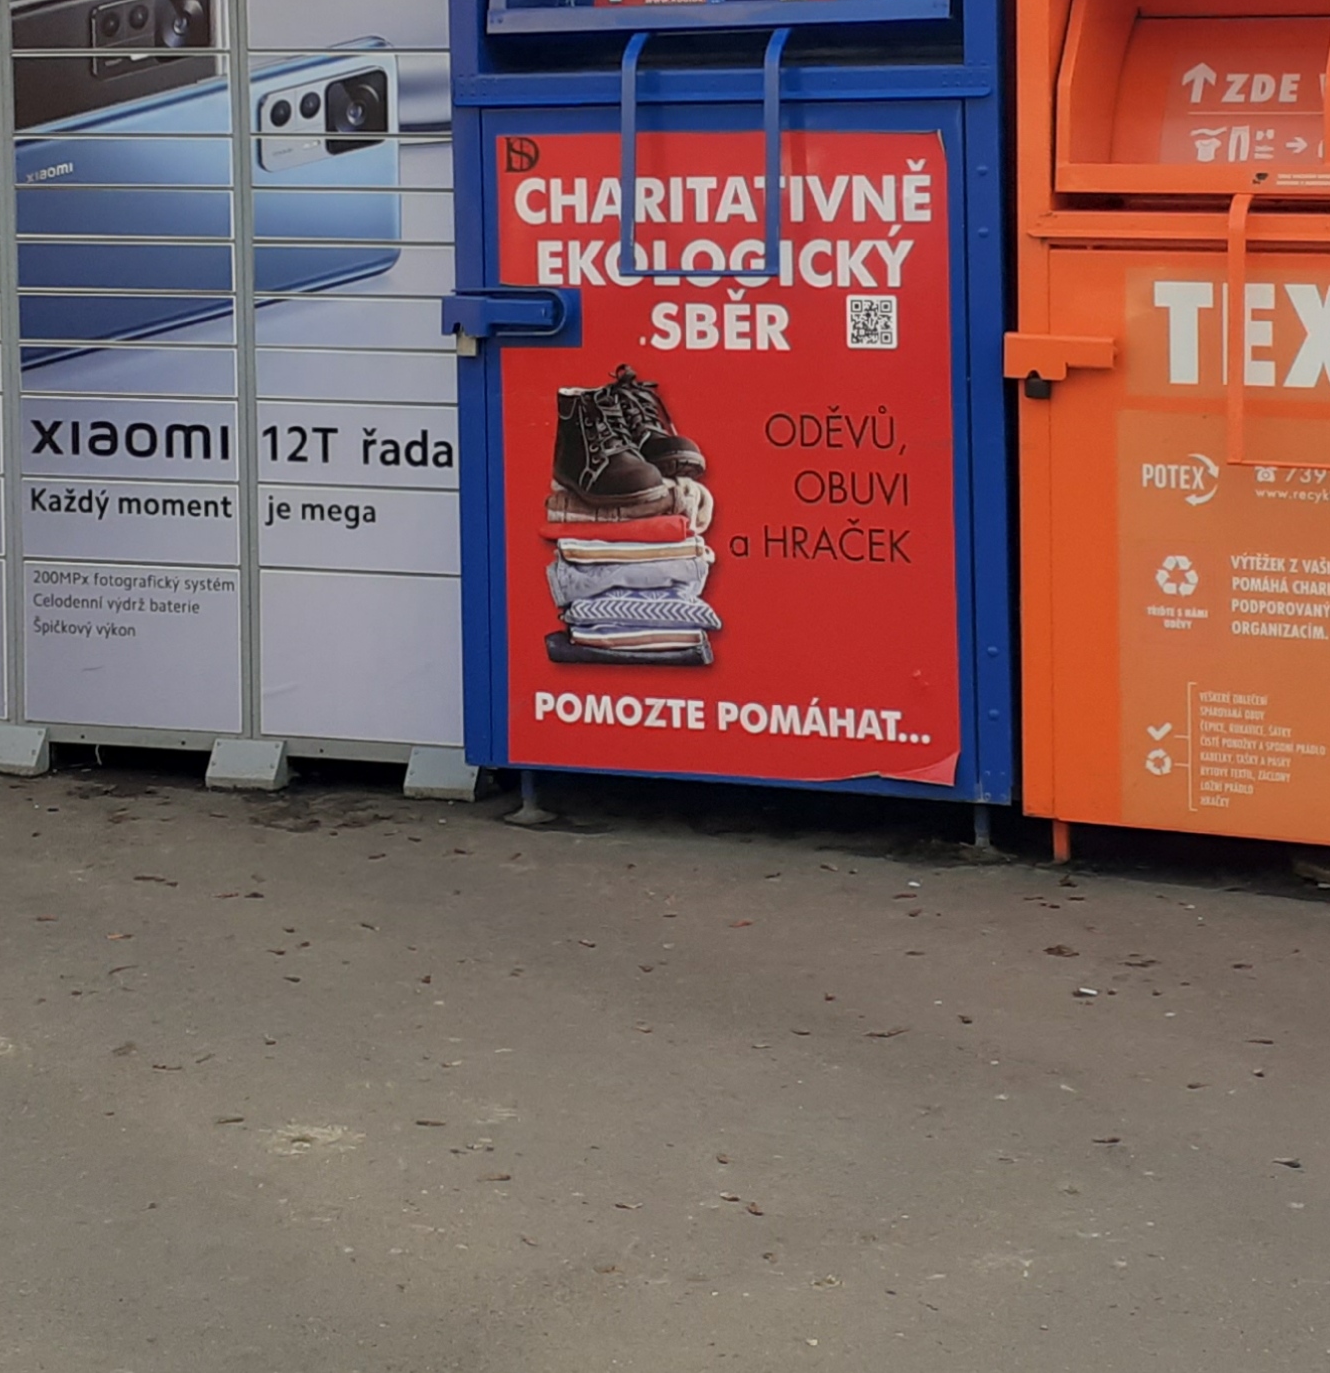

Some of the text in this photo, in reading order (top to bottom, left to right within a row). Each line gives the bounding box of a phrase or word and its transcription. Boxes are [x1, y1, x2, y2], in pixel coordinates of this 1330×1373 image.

[1221, 73, 1301, 103] ZDE
[537, 224, 914, 288] EKOLOGICKÝ
[30, 419, 454, 468] xiaomi 12T řada
[765, 405, 907, 455] ODĚVŮ,
[794, 470, 909, 506] OBUVI
[1142, 463, 1206, 491] POTEX
[31, 487, 377, 530] Každý moment je mega
[730, 518, 912, 564] a HRAČEK
[1231, 552, 1285, 572] VÝTĚŽEK
[1290, 559, 1299, 573] Z
[33, 570, 236, 594] 200MPx fotografický systém
[1232, 575, 1289, 594] POMÁHÁ
[33, 593, 200, 614] Celodenní výdrž baterie
[33, 616, 136, 639] Špičkový výkon
[1231, 621, 1328, 641] ORGANIZACÍM.
[535, 691, 932, 745] POMOZTE POMÁHAT...
